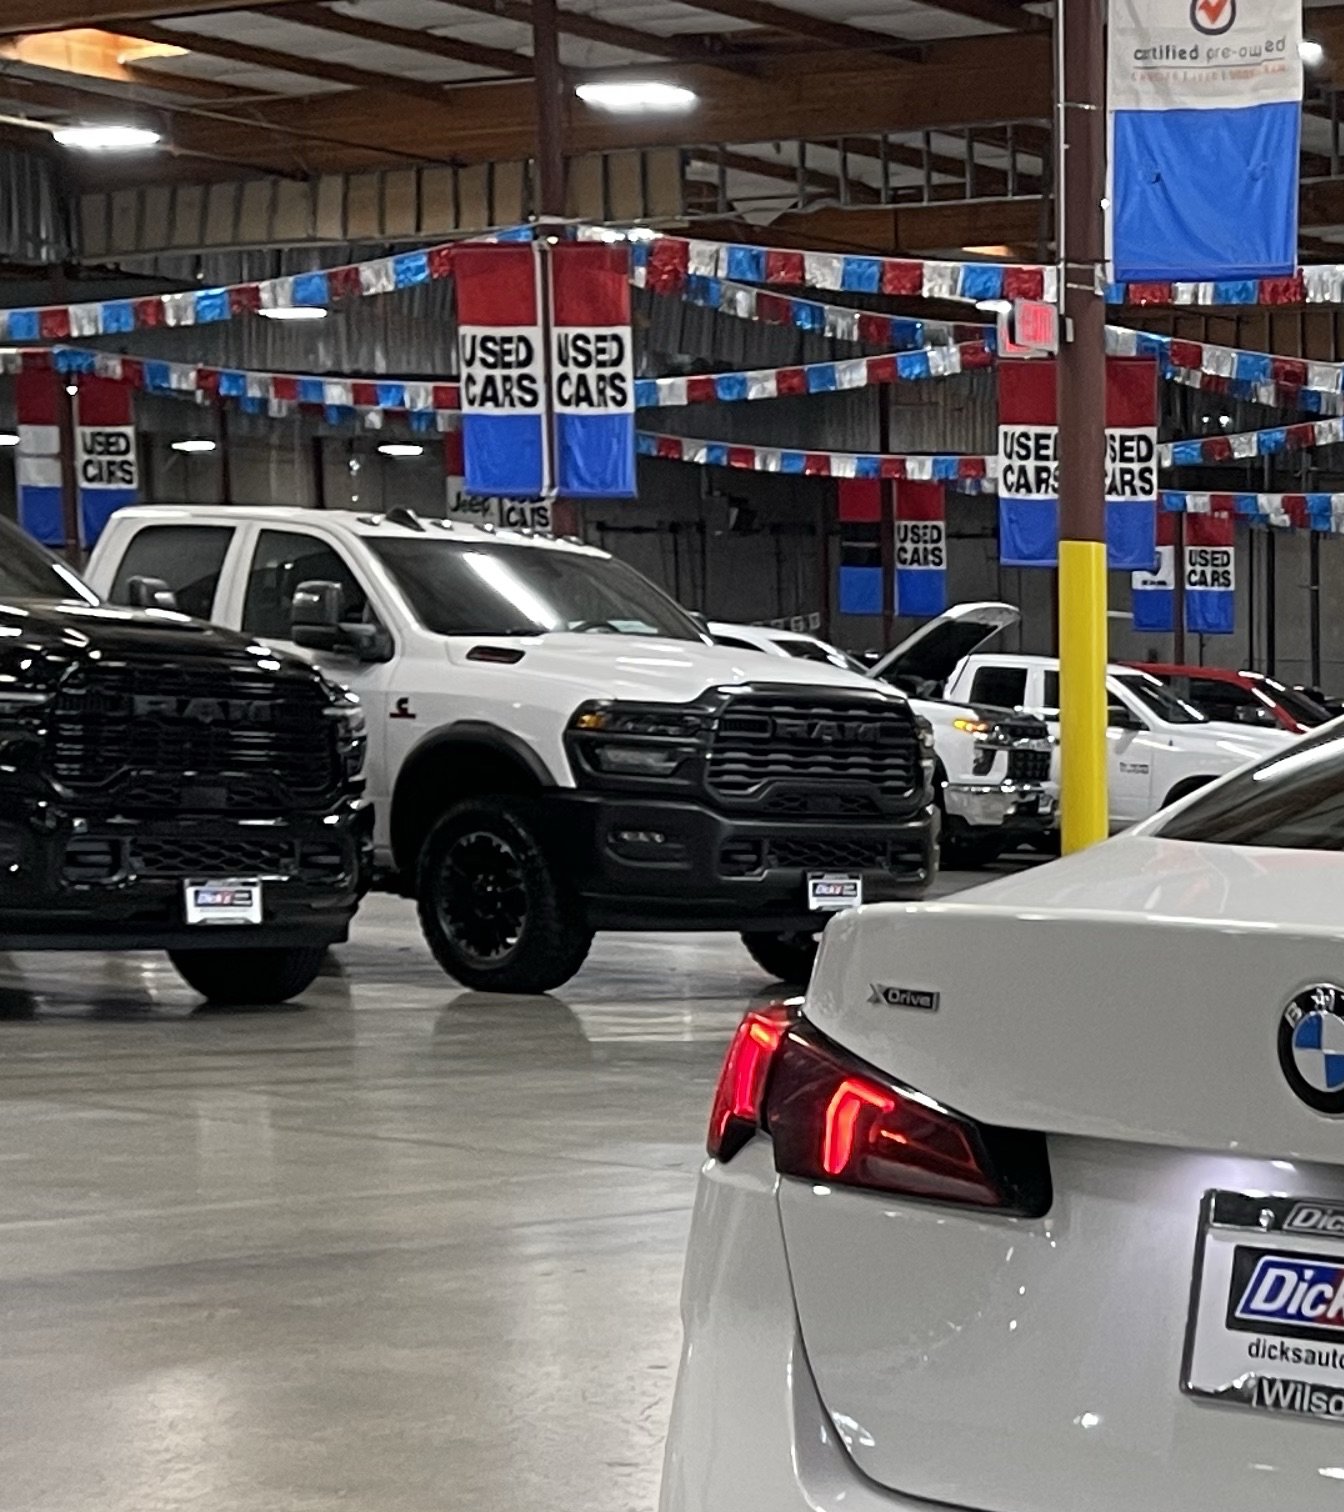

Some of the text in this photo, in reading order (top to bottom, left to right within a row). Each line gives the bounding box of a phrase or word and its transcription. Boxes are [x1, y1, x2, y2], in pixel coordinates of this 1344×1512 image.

[1206, 35, 1287, 62] pre-owed
[461, 334, 533, 369] USED
[558, 333, 625, 368] USED
[464, 373, 538, 407] CARS
[557, 372, 627, 407] CARS
[81, 432, 131, 455] USED
[1108, 434, 1154, 463] SED
[1105, 467, 1154, 496] ARS
[897, 524, 942, 544] USED
[1188, 549, 1231, 568] USED
[1188, 570, 1231, 588] CARS
